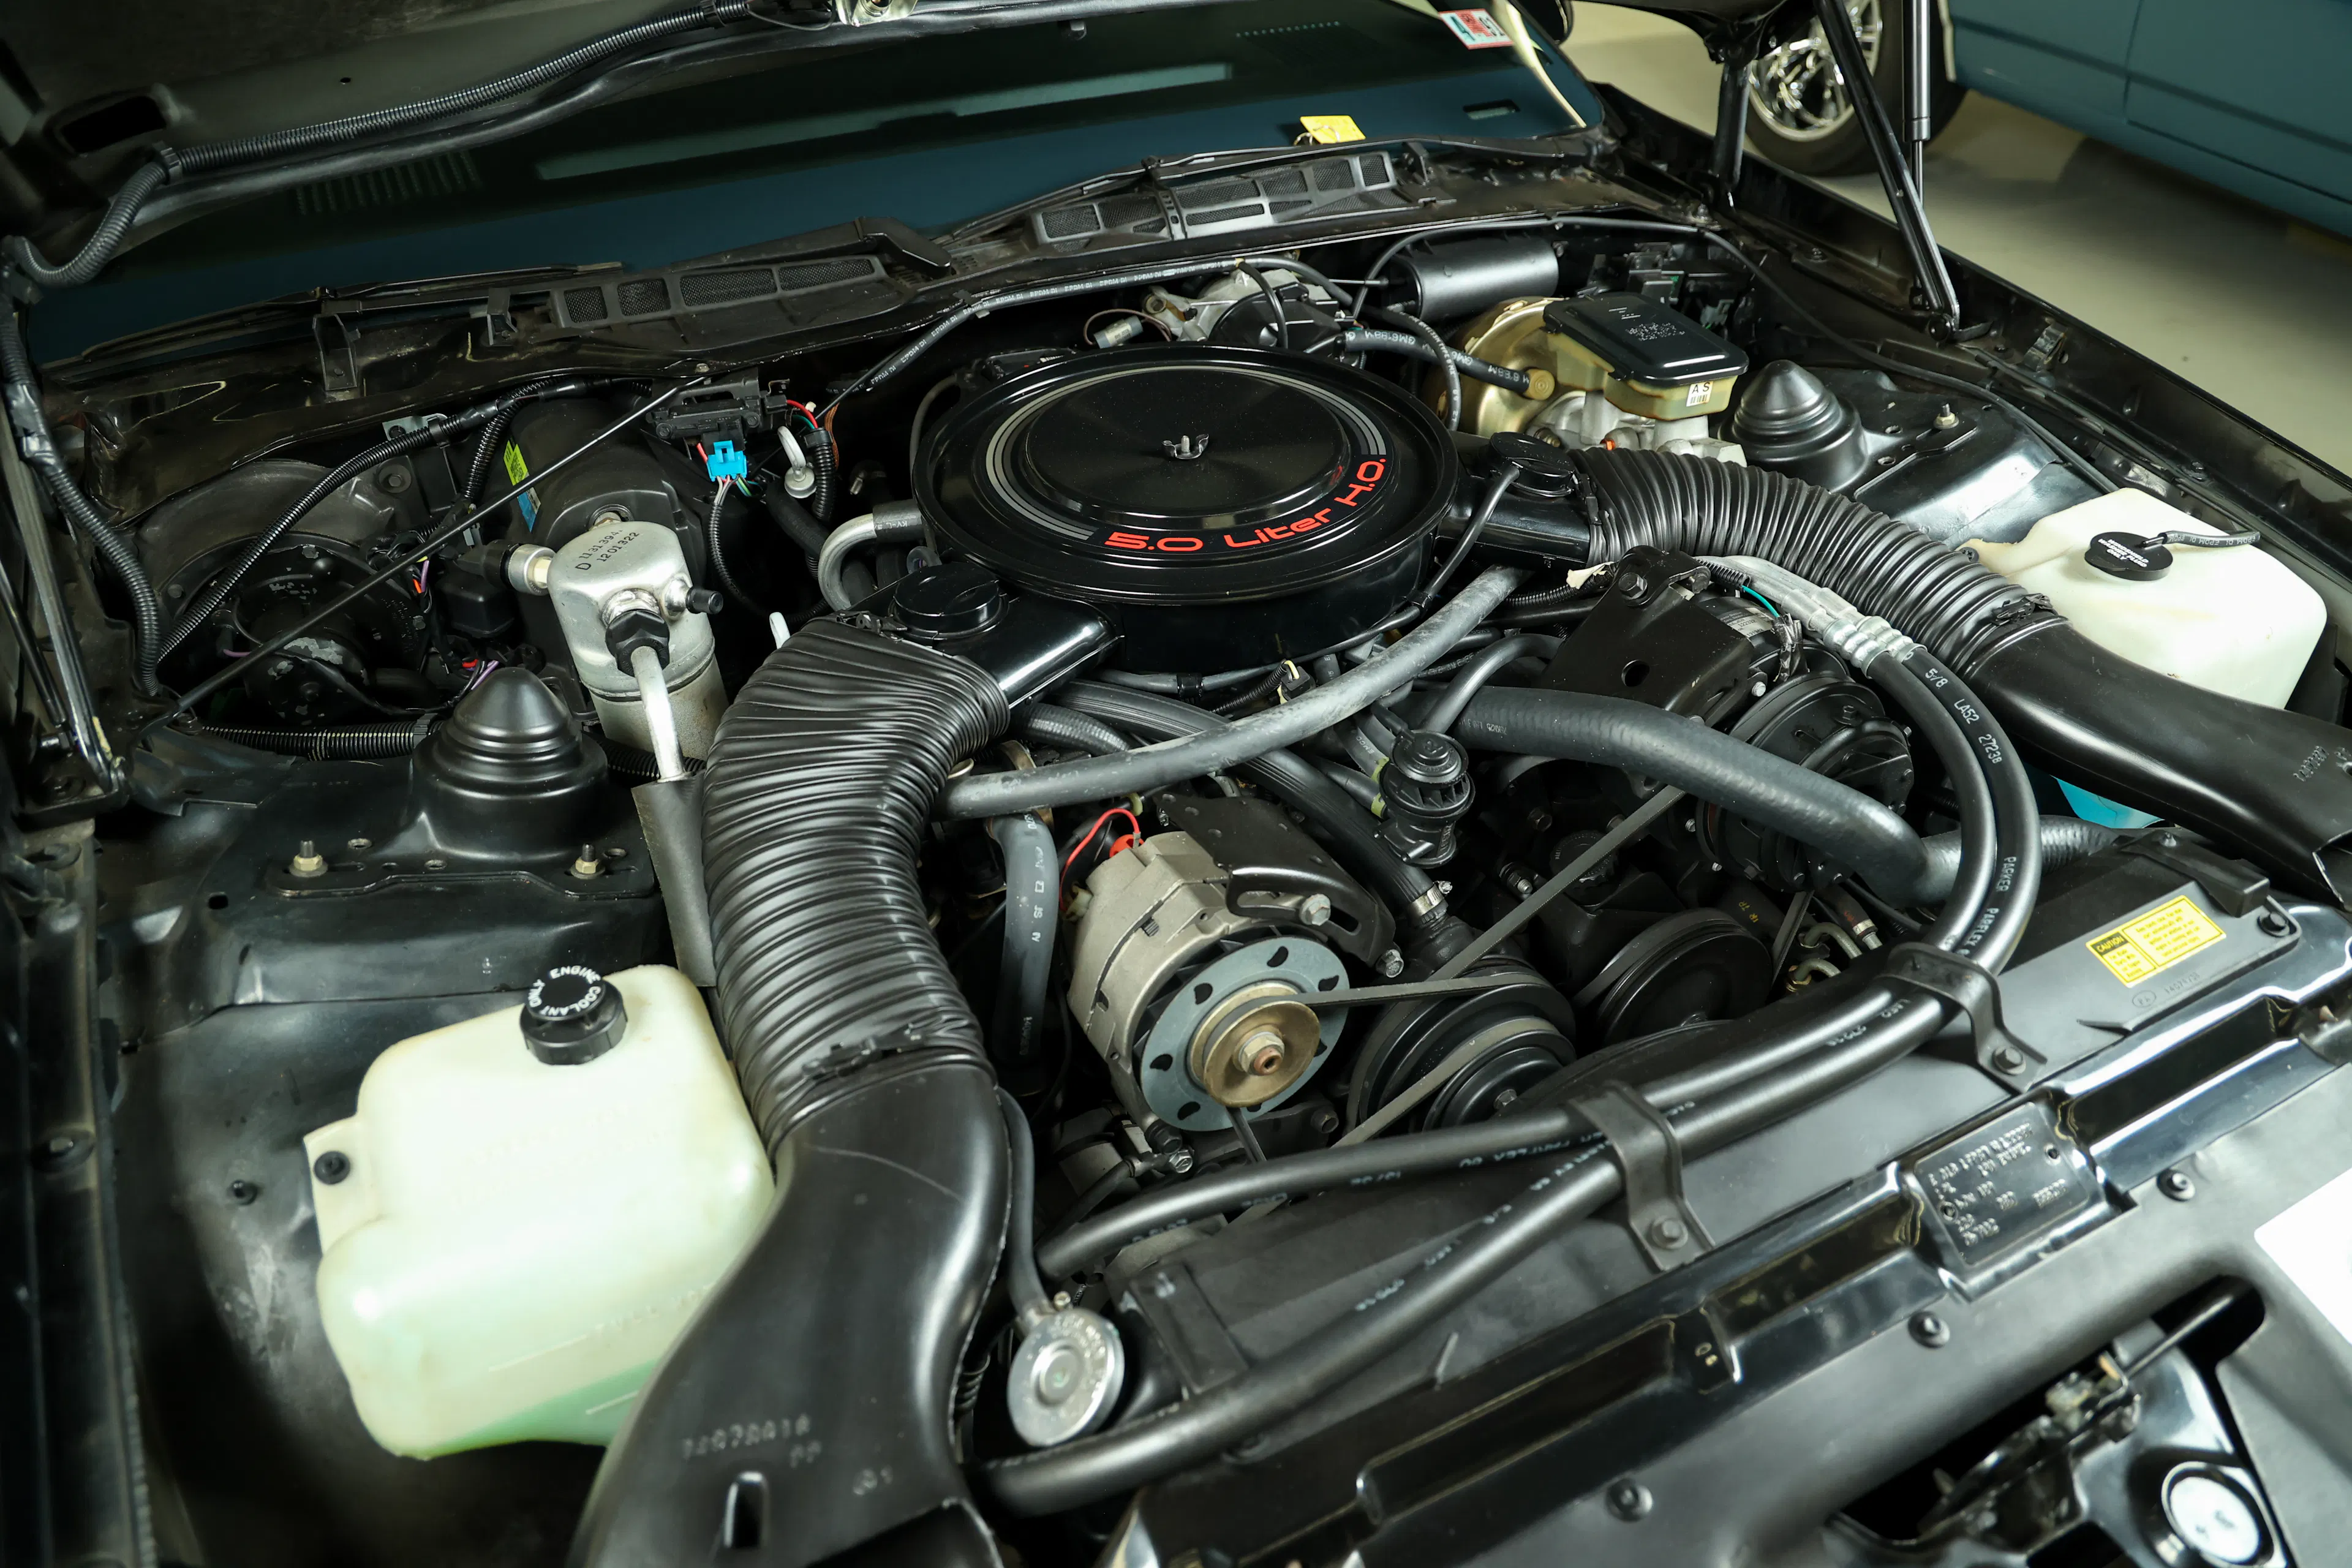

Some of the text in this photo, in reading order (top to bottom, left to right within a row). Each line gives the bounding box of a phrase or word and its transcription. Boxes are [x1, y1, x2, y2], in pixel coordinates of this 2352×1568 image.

[1104, 458, 1386, 551] 5.0 Liter H.O.
[2098, 538, 2147, 567] WASHER FLUID
[2106, 549, 2127, 560] ONLY
[2108, 539, 2149, 563] WINDSHIELD
[1925, 668, 1948, 688] 5/8
[1954, 698, 1980, 725] LA52
[1355, 736, 1375, 755] EMCO
[2095, 933, 2125, 954] CAUTION
[550, 965, 601, 984] ENGINE
[528, 979, 545, 1008] ONLY
[540, 986, 601, 1016] COOLANT
